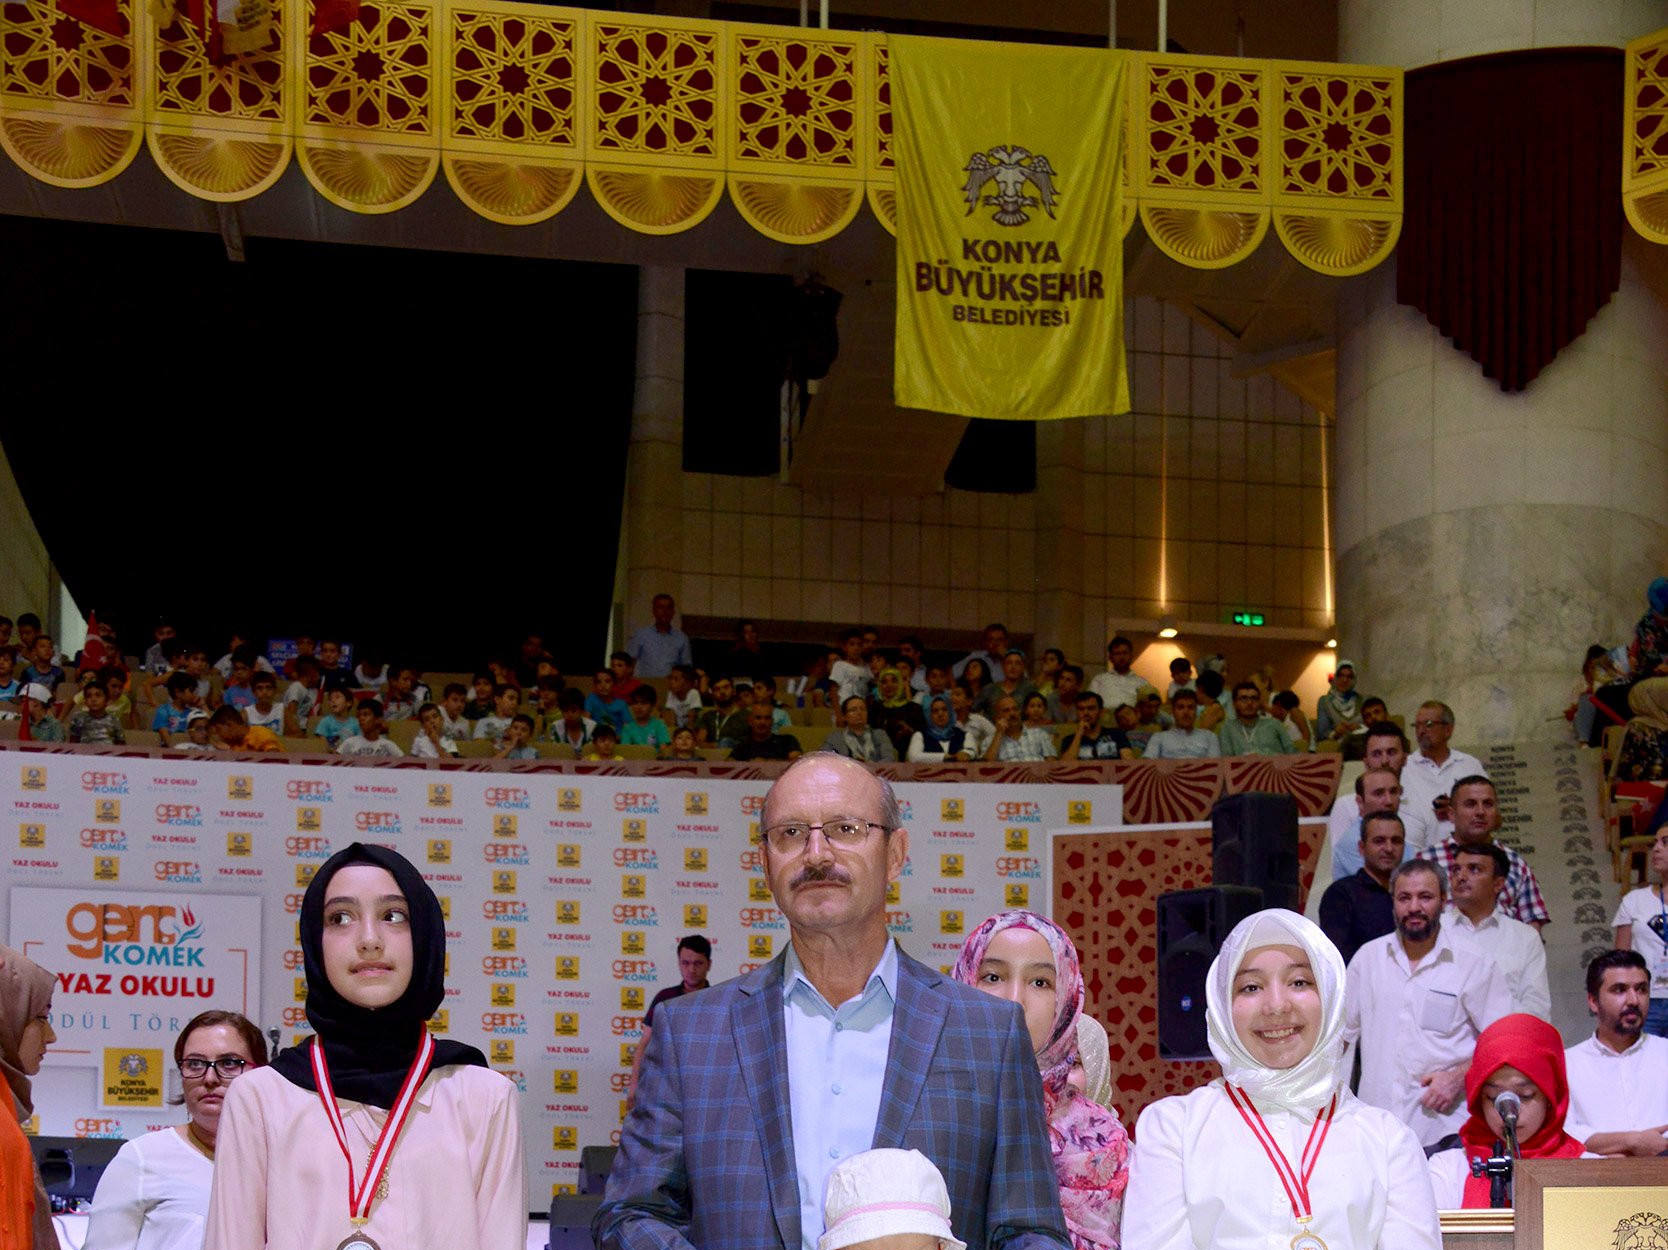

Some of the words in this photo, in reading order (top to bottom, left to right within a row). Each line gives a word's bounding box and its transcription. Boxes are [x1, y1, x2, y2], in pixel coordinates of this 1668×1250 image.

[962, 238, 1062, 264] KONYA
[916, 259, 1104, 306] BÜYÜKŞEHİR
[953, 304, 1070, 326] BELEDİYESİ
[94, 786, 130, 794] KOMEK
[298, 794, 334, 802] KOMEK
[496, 801, 530, 809] KOMEK
[168, 818, 203, 827] KOMEK
[368, 826, 403, 834] KOMEK
[93, 843, 128, 851] KOMEK
[167, 875, 202, 884] KOMEK
[495, 914, 529, 922] KOMEK
[66, 902, 176, 960] genç
[104, 944, 205, 967] KOMEK
[57, 973, 112, 994] YAZ
[120, 975, 214, 998] OKULU
